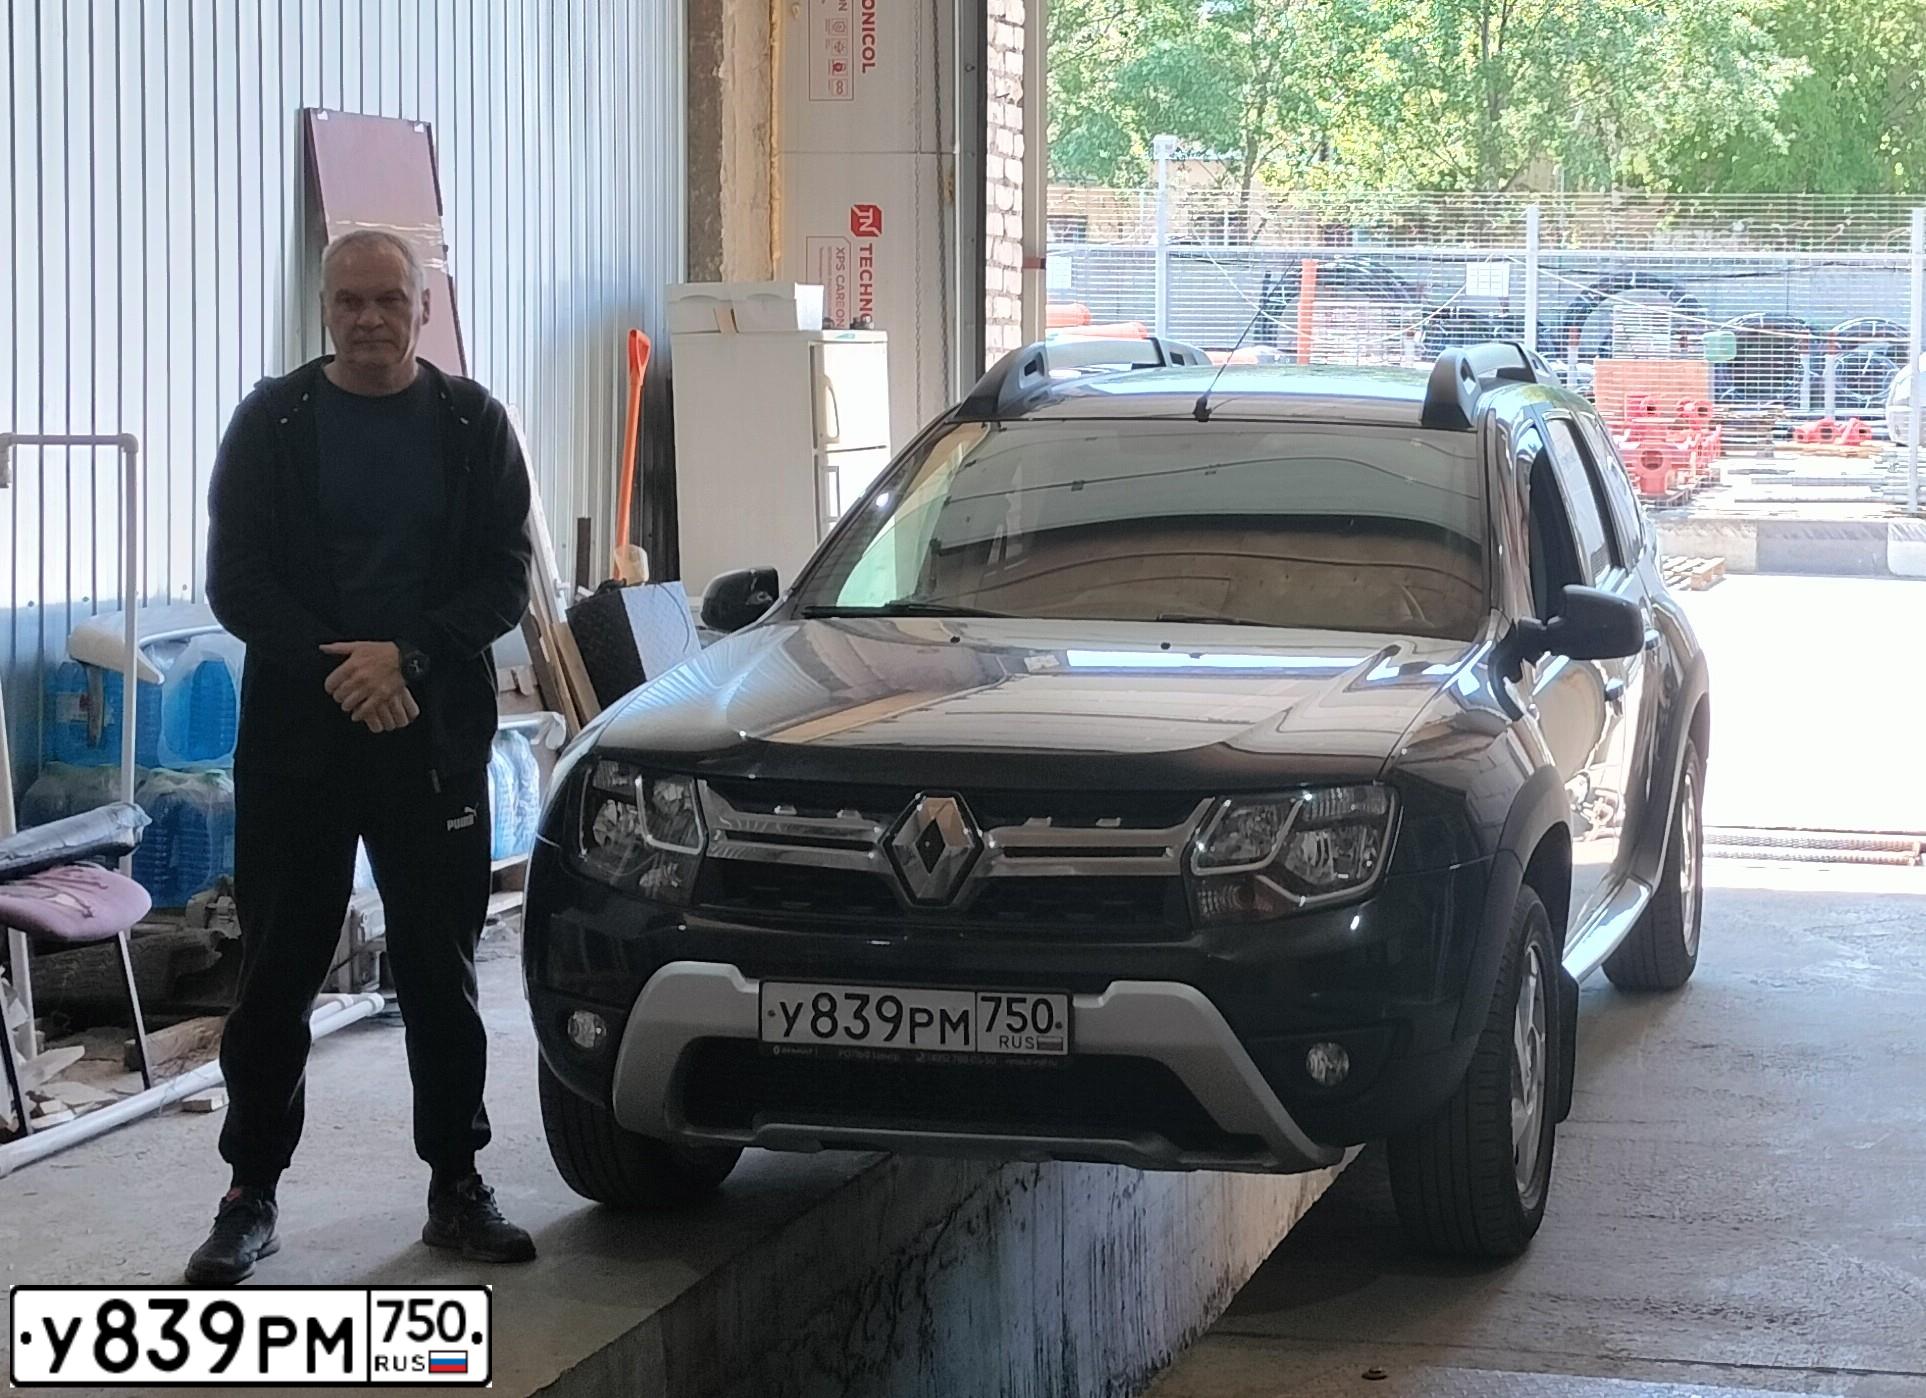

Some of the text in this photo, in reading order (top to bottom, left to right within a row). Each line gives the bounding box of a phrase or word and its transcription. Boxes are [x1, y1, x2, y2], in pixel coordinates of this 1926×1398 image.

[835, 247, 845, 272] XPS
[980, 995, 1054, 1034] 750
[1000, 1035, 1035, 1051] RUS
